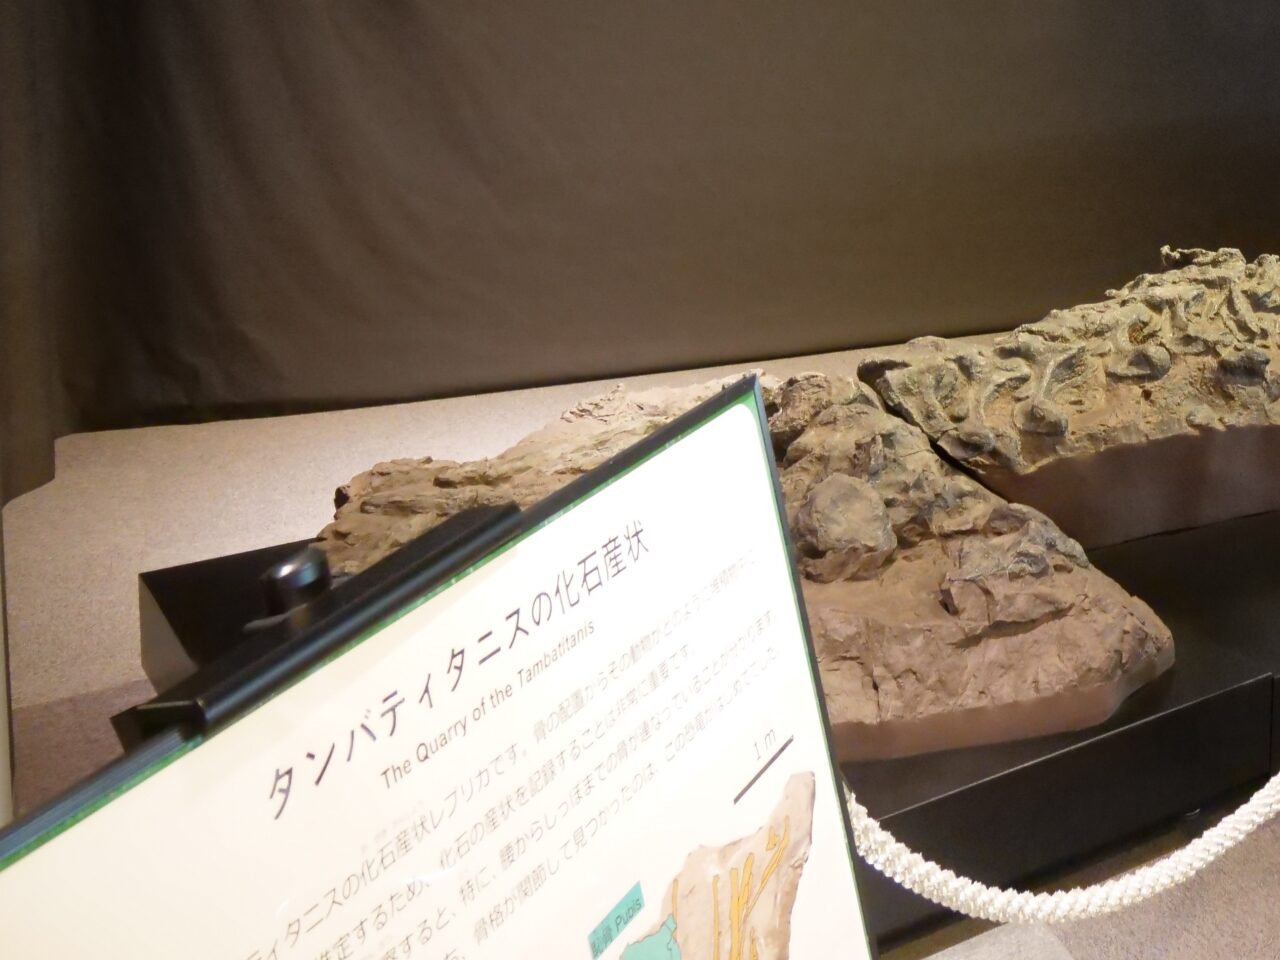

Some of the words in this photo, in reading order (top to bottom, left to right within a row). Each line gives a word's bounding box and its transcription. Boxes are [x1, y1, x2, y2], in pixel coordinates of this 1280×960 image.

[269, 520, 649, 820] タンバティタニスの化石産状
[380, 759, 412, 789] The
[416, 716, 467, 763] Quarry
[472, 697, 486, 722] of
[490, 684, 513, 709] the
[517, 620, 595, 688] Tambatitanis
[614, 898, 643, 933] Pubis
